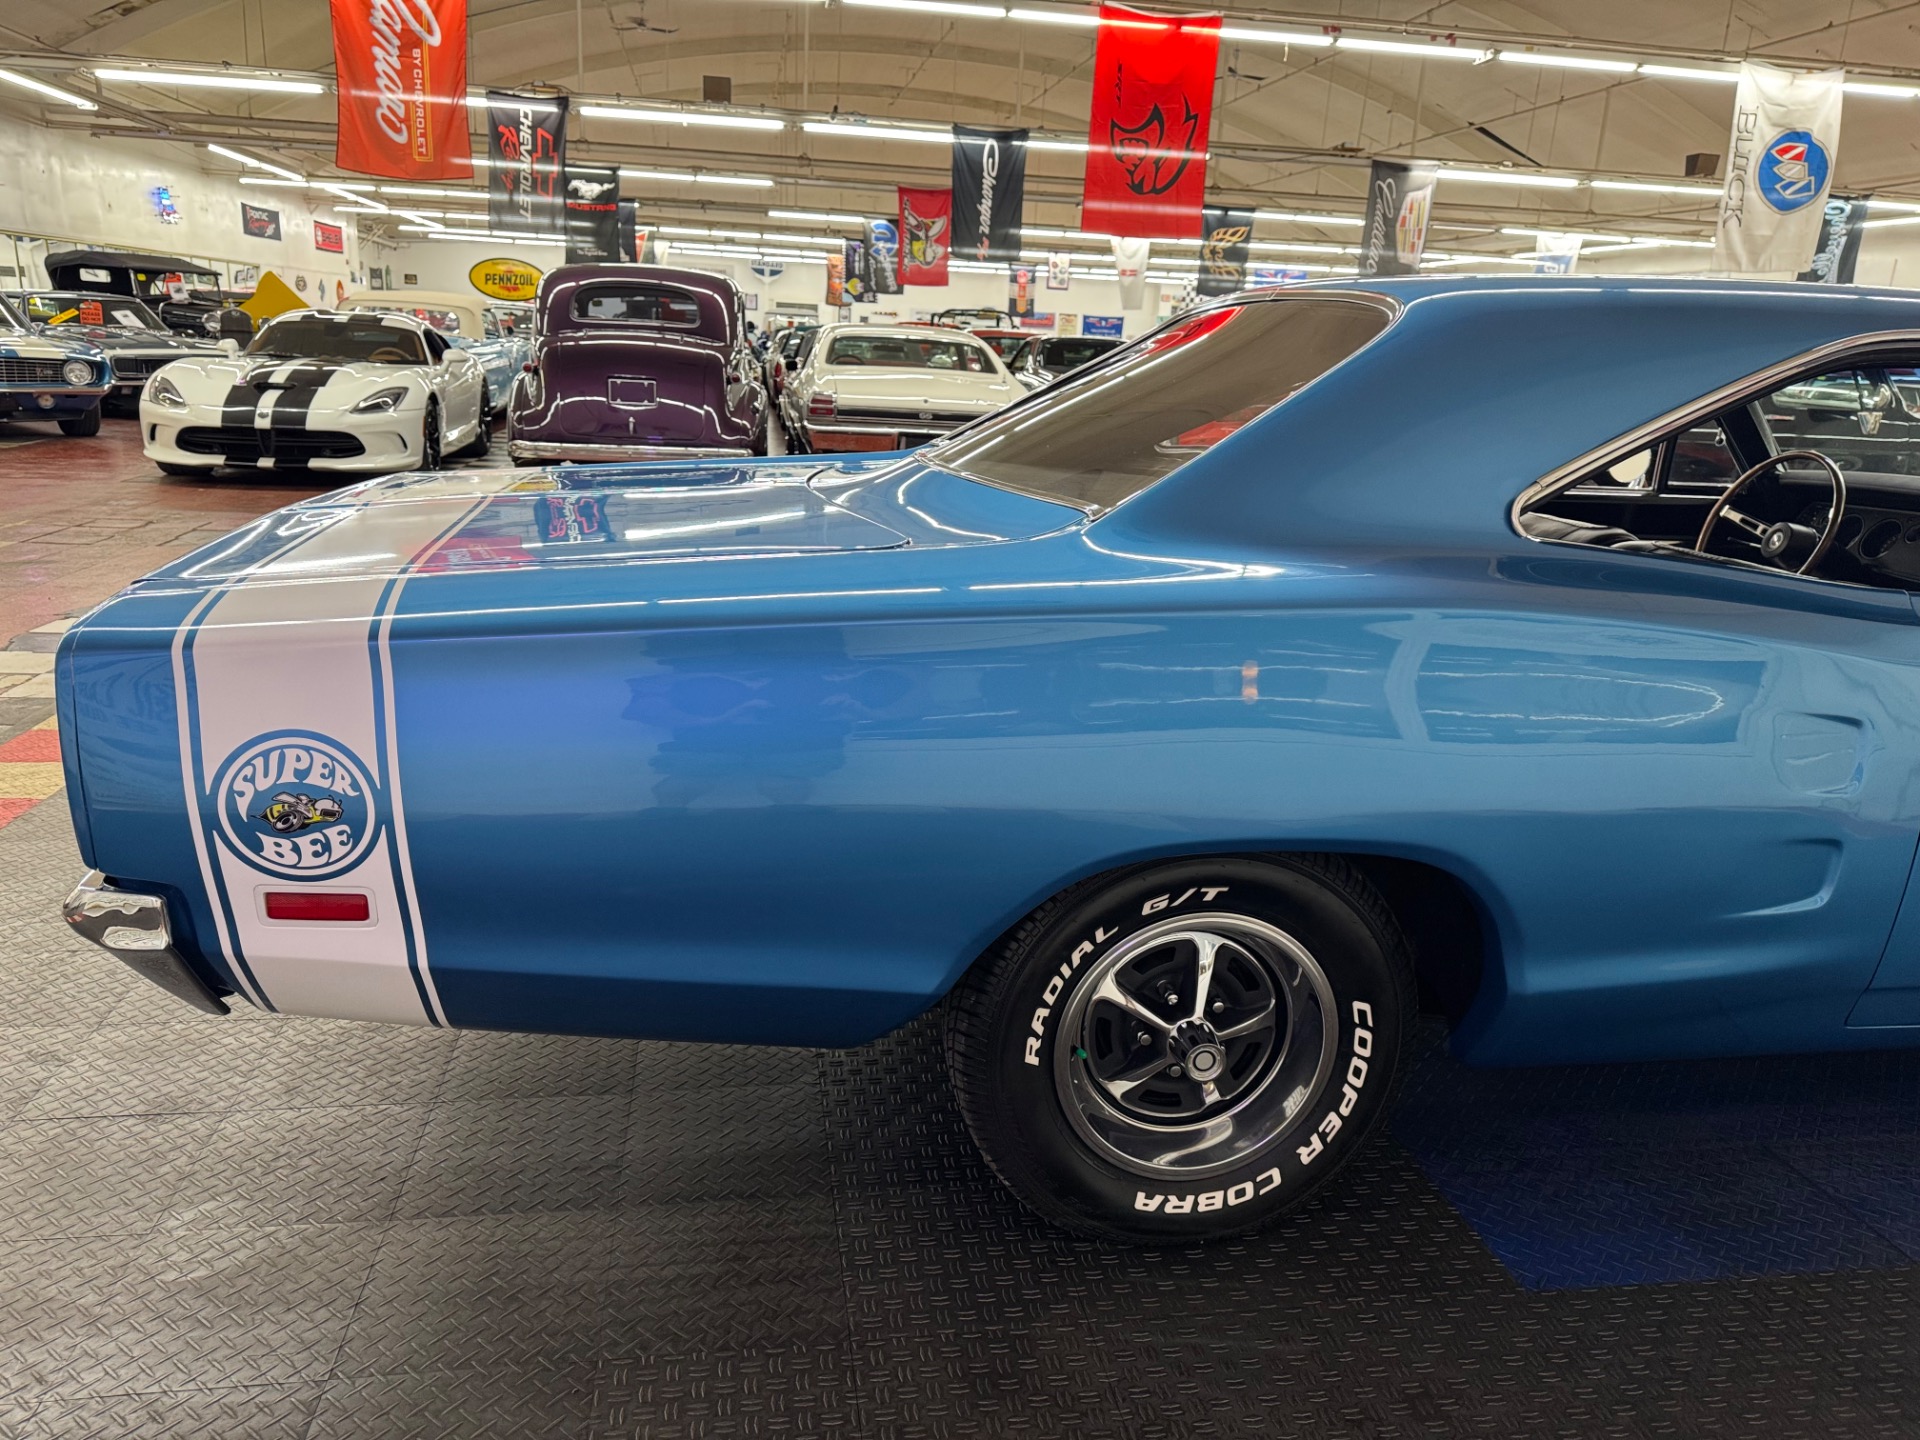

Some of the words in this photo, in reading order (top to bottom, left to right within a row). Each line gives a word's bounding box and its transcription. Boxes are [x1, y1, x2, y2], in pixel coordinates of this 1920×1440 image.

[412, 48, 421, 66] BY
[412, 69, 427, 154] CHEVROLET
[498, 124, 520, 193] Racing
[519, 106, 533, 223] CHEVROLET
[976, 138, 999, 234] Charger
[1722, 105, 1759, 228] BUICK
[566, 202, 617, 211] MUSTANG
[1366, 178, 1396, 273] Cadillac
[485, 273, 534, 286] PENNZOIL
[232, 747, 360, 822] SUPER
[255, 824, 353, 867] BEE
[1024, 926, 1119, 1066] RADIAL
[1141, 887, 1229, 916] G/T
[1295, 1000, 1374, 1165] COOPER
[1133, 1167, 1282, 1214] COBRA
